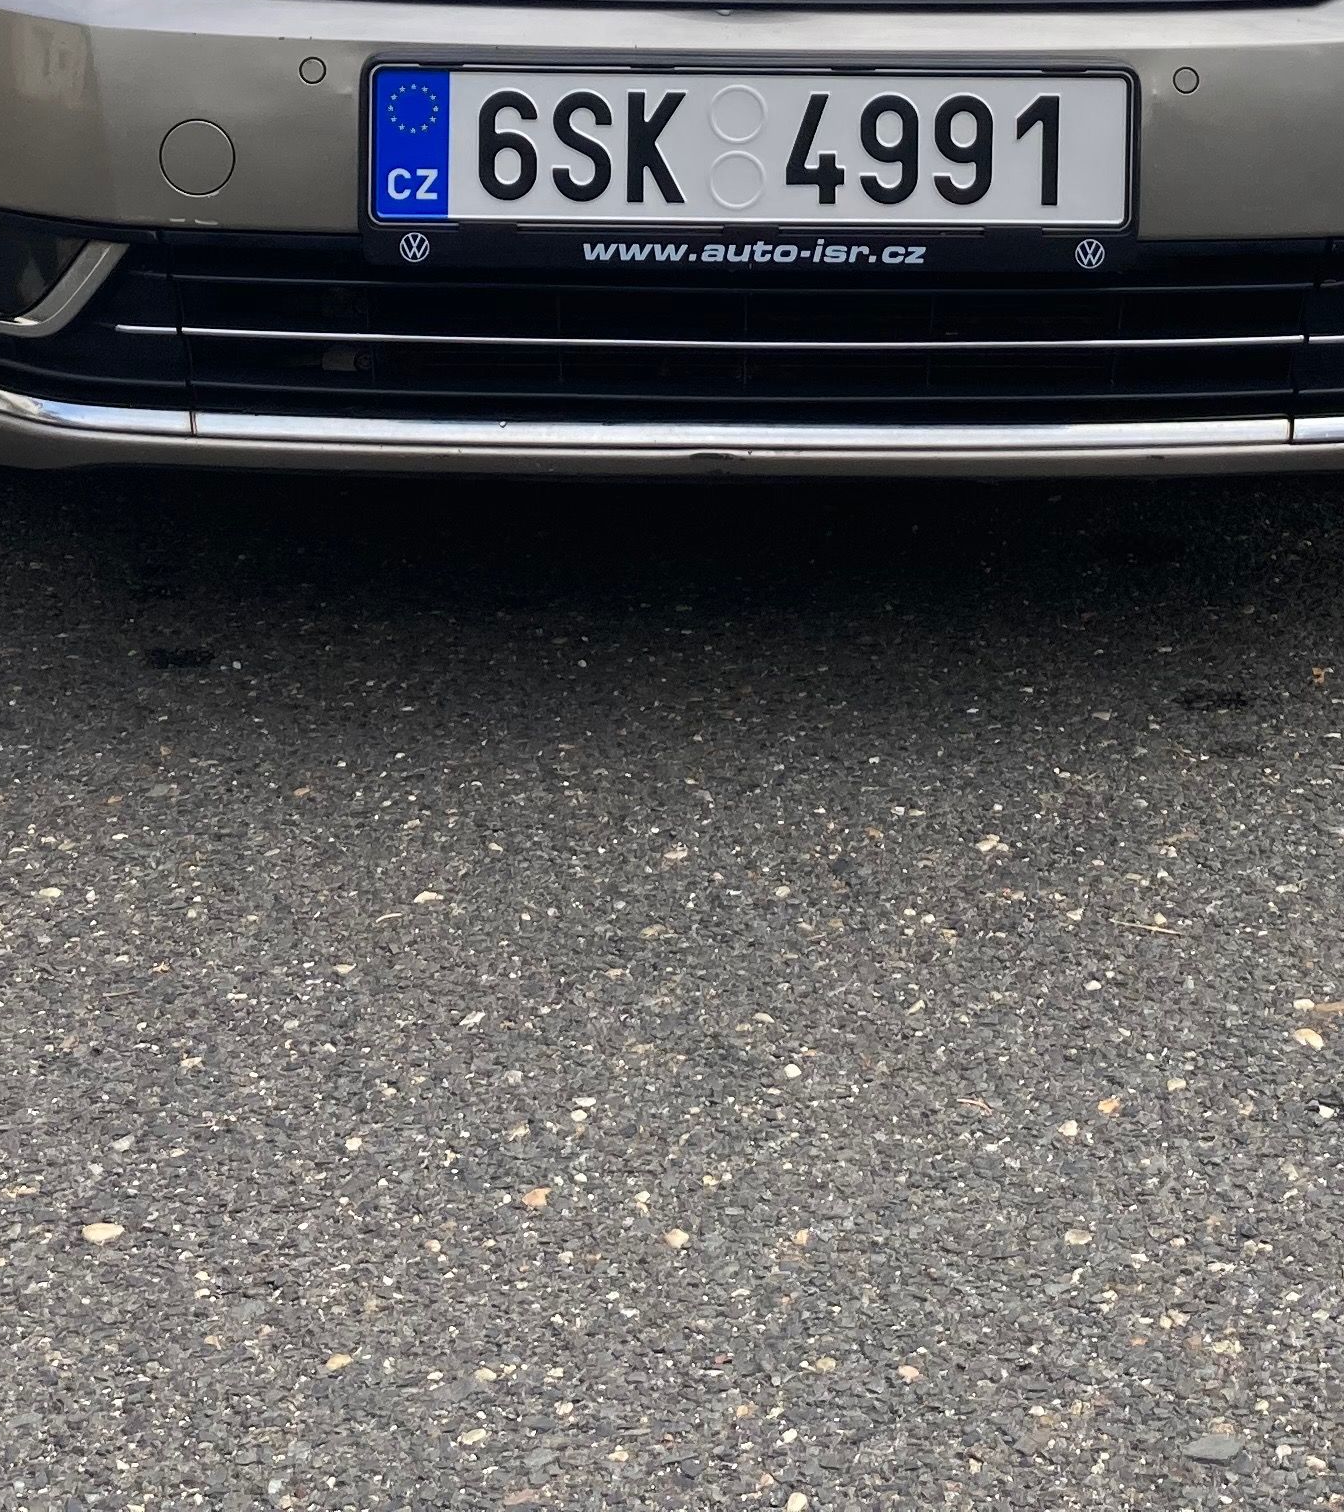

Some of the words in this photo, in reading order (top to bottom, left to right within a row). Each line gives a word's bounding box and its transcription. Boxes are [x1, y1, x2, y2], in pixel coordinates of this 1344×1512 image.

[478, 90, 687, 204] 6SK
[785, 93, 1061, 207] 4991
[387, 168, 439, 200] CZ
[582, 238, 927, 264] www.auto-isr.cz
